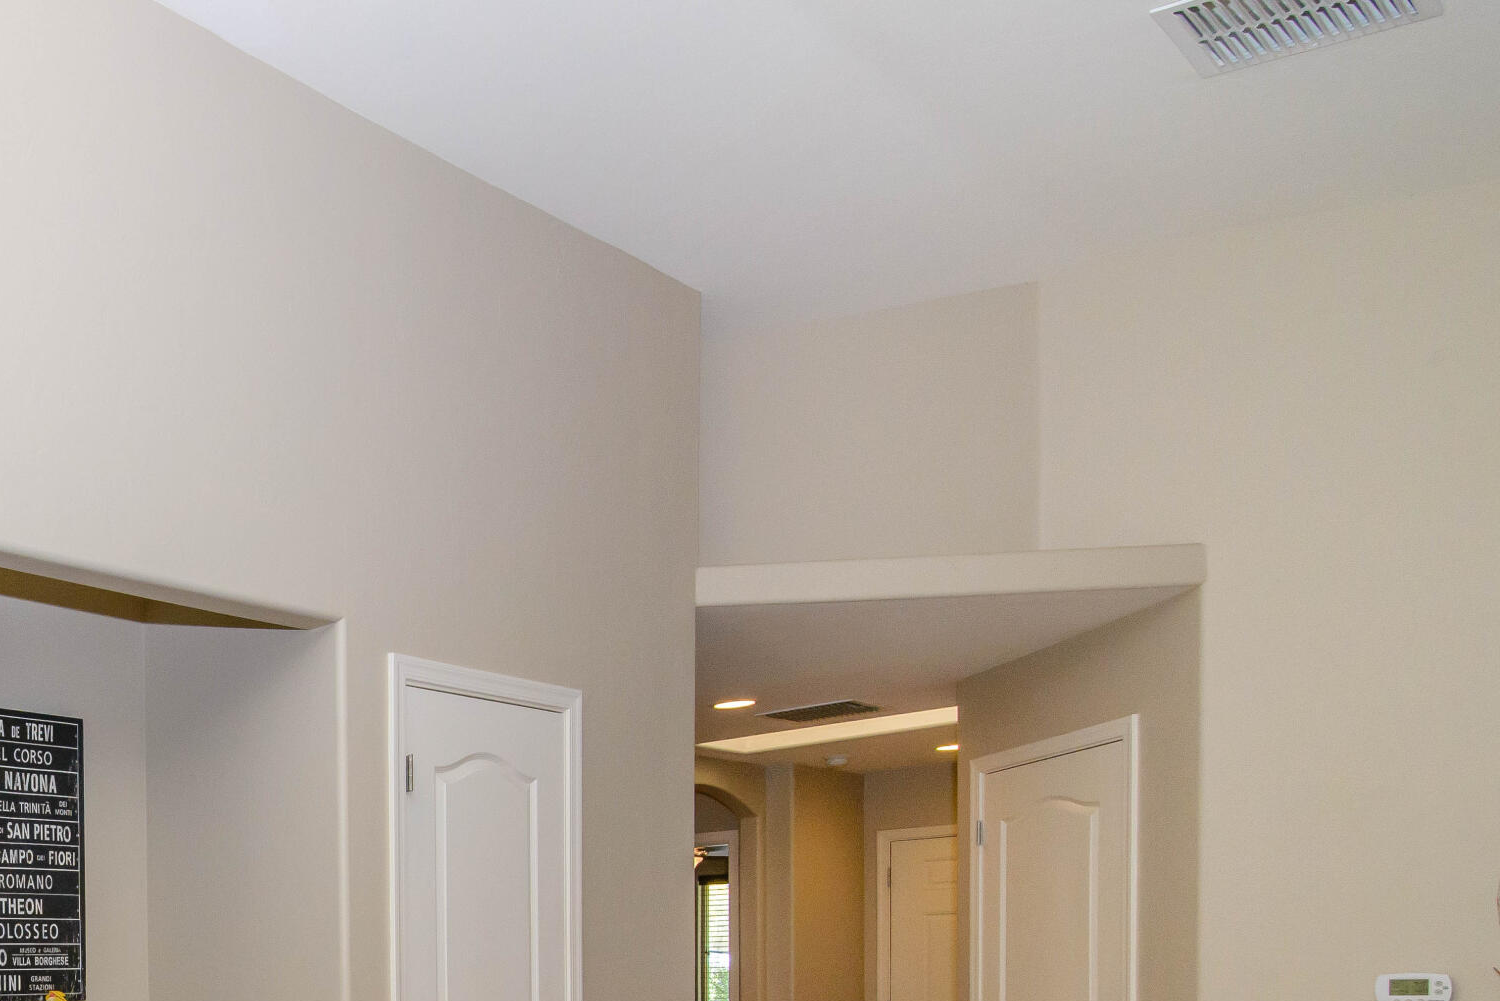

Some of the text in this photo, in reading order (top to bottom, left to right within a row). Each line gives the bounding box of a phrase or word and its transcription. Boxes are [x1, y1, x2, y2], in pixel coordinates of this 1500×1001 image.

[12, 726, 20, 738] DE
[26, 723, 54, 742] TREVI
[14, 748, 52, 765] CORSO
[4, 770, 57, 794] NAVONA
[7, 822, 30, 840] SAN
[34, 824, 72, 842] PIETRO
[48, 850, 76, 866] FIORI
[12, 956, 68, 966] VILLA BORGHESE
